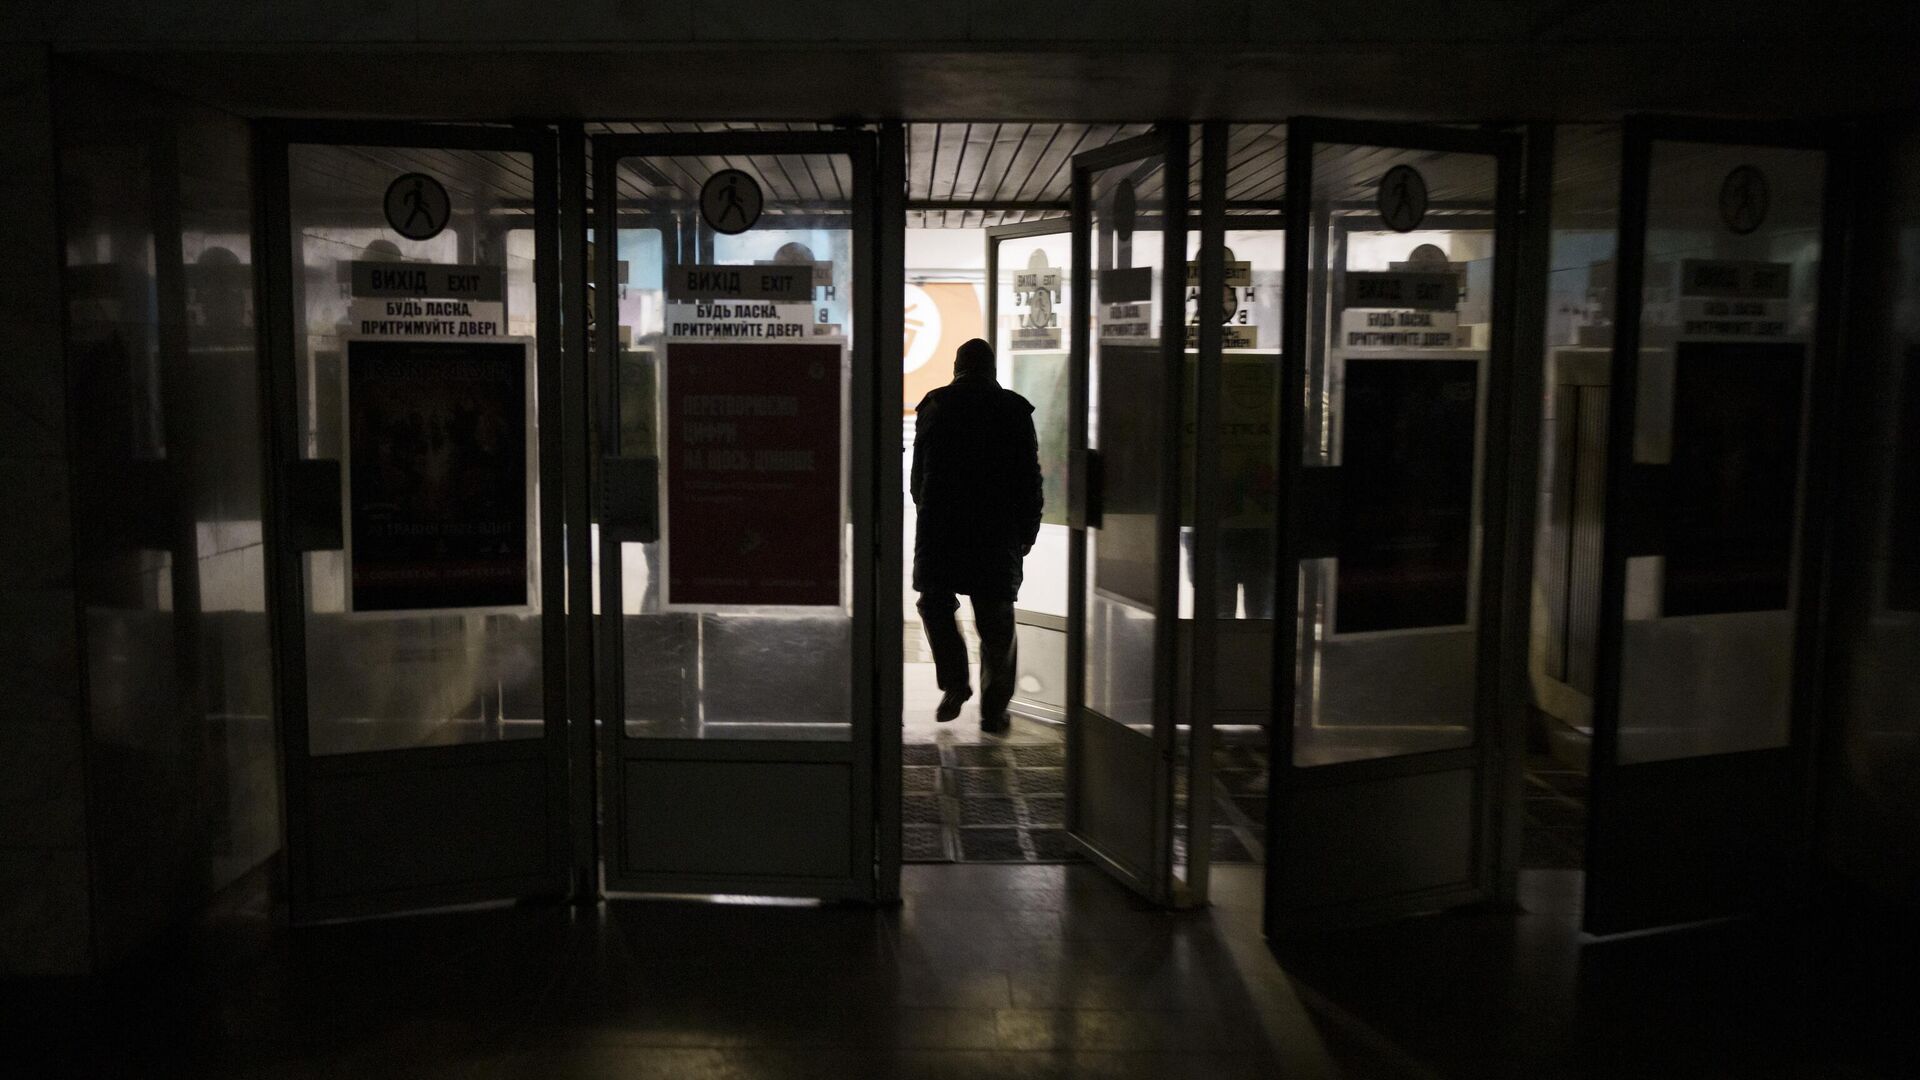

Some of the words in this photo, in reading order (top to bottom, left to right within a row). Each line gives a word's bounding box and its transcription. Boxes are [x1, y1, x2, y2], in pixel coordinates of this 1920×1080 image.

[371, 269, 427, 294] ВИХІД
[448, 274, 480, 292] EXIT
[687, 272, 741, 294] ВИХІД
[761, 275, 794, 292] EXIT
[386, 302, 422, 317] БУДЬ
[425, 302, 472, 317] ЛАСКА,
[696, 305, 731, 319] БУДЬ
[734, 305, 781, 319] ЛАСКА,
[361, 319, 455, 335] ПРИТРИМУЙТЕ
[458, 321, 497, 337] ДВЕРІ
[673, 321, 762, 337] ПРИТРИМУЙТЕ
[765, 323, 804, 338] ДВЕРІ
